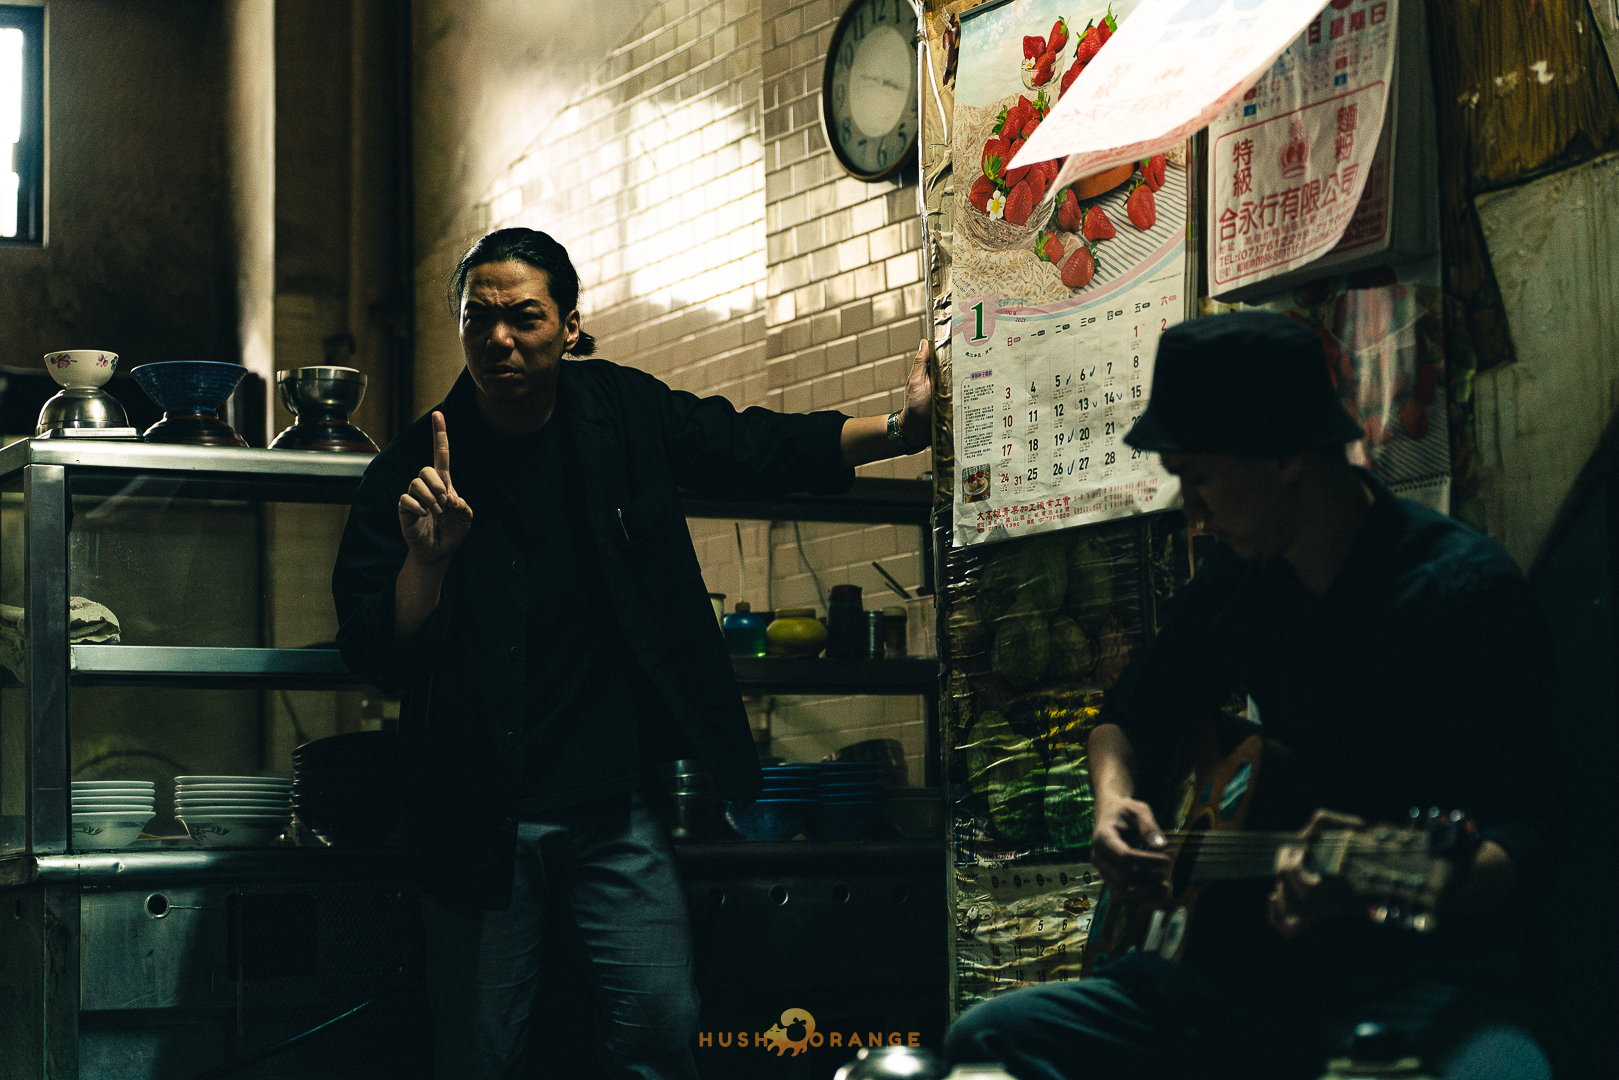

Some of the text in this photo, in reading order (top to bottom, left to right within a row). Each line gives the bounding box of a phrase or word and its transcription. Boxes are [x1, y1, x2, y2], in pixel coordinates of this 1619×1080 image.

[853, 13, 864, 41] 11
[834, 82, 846, 113] 9
[842, 117, 851, 145] 8
[897, 122, 907, 154] 5
[857, 138, 867, 165] 7
[877, 137, 887, 169] 6
[1233, 138, 1254, 198] 特級
[1219, 163, 1360, 242] 台永行有限公司
[970, 301, 988, 341] 1
[1007, 337, 1013, 347] 日
[1055, 325, 1062, 334] 二
[1080, 317, 1087, 327] 三
[1106, 310, 1114, 320] 四
[1134, 302, 1142, 313] 五
[1161, 296, 1168, 306] 六
[1133, 318, 1168, 337] 1 2
[1005, 387, 1011, 399] 3
[1030, 381, 1036, 393] 4
[1055, 375, 1060, 387] 5
[1080, 368, 1086, 381] 6
[1106, 362, 1112, 374] 7
[1133, 355, 1139, 368] 8
[1003, 385, 1142, 428] 10 11 12 13 14 15
[1001, 443, 1012, 456] 17
[1028, 438, 1038, 452] 18
[1054, 433, 1064, 446] 19
[1079, 427, 1090, 441] 20
[1105, 421, 1114, 435] 21
[1000, 473, 1009, 483] 24
[1014, 475, 1022, 486] 31
[1027, 467, 1038, 481] 25
[1053, 462, 1063, 476] 26
[1078, 456, 1089, 471] 27
[1104, 451, 1115, 465] 28
[1037, 919, 1044, 931] 5
[1062, 918, 1068, 931] 6
[1086, 918, 1092, 930] 7
[1013, 944, 1022, 957] 11
[1035, 944, 1045, 957] 12
[1014, 969, 1024, 982] 18
[1036, 969, 1046, 982] 19
